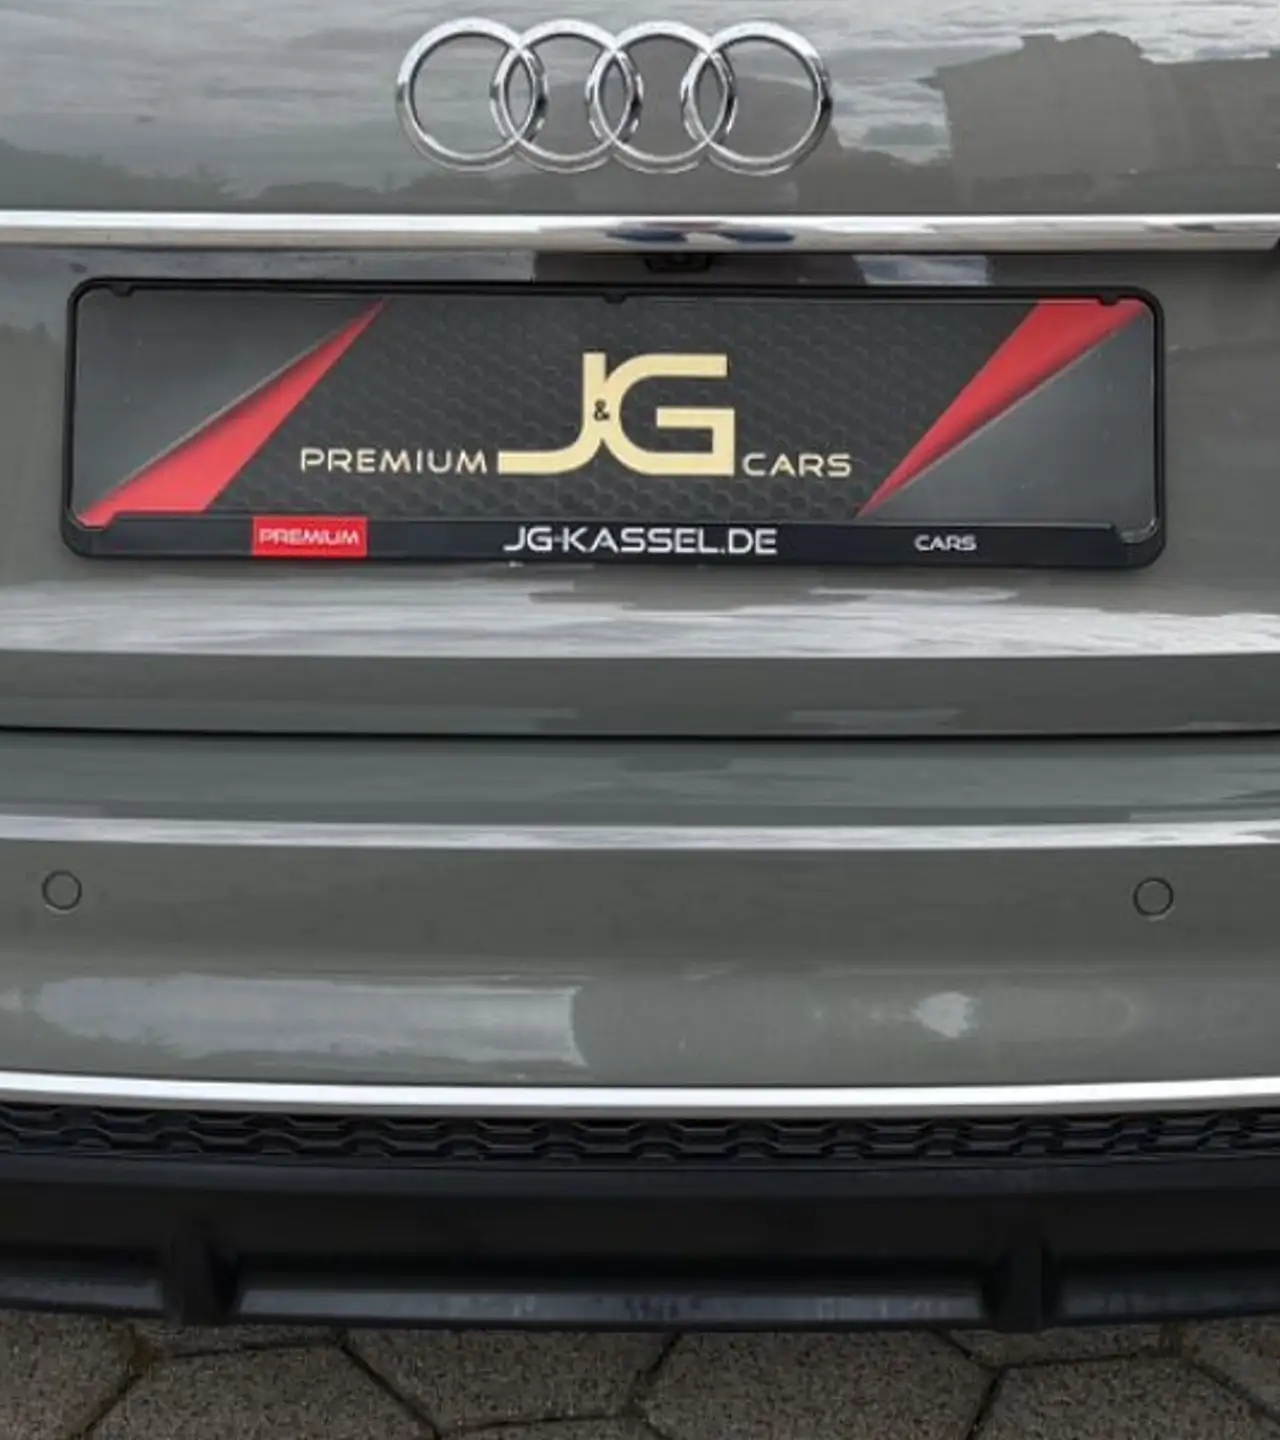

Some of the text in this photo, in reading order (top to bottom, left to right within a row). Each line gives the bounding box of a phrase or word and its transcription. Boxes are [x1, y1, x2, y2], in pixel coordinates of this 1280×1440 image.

[300, 446, 488, 474] PREMIUM
[742, 452, 852, 477] CARS
[258, 525, 978, 555] PREMIUM JG-KASSEL.DE CARS
